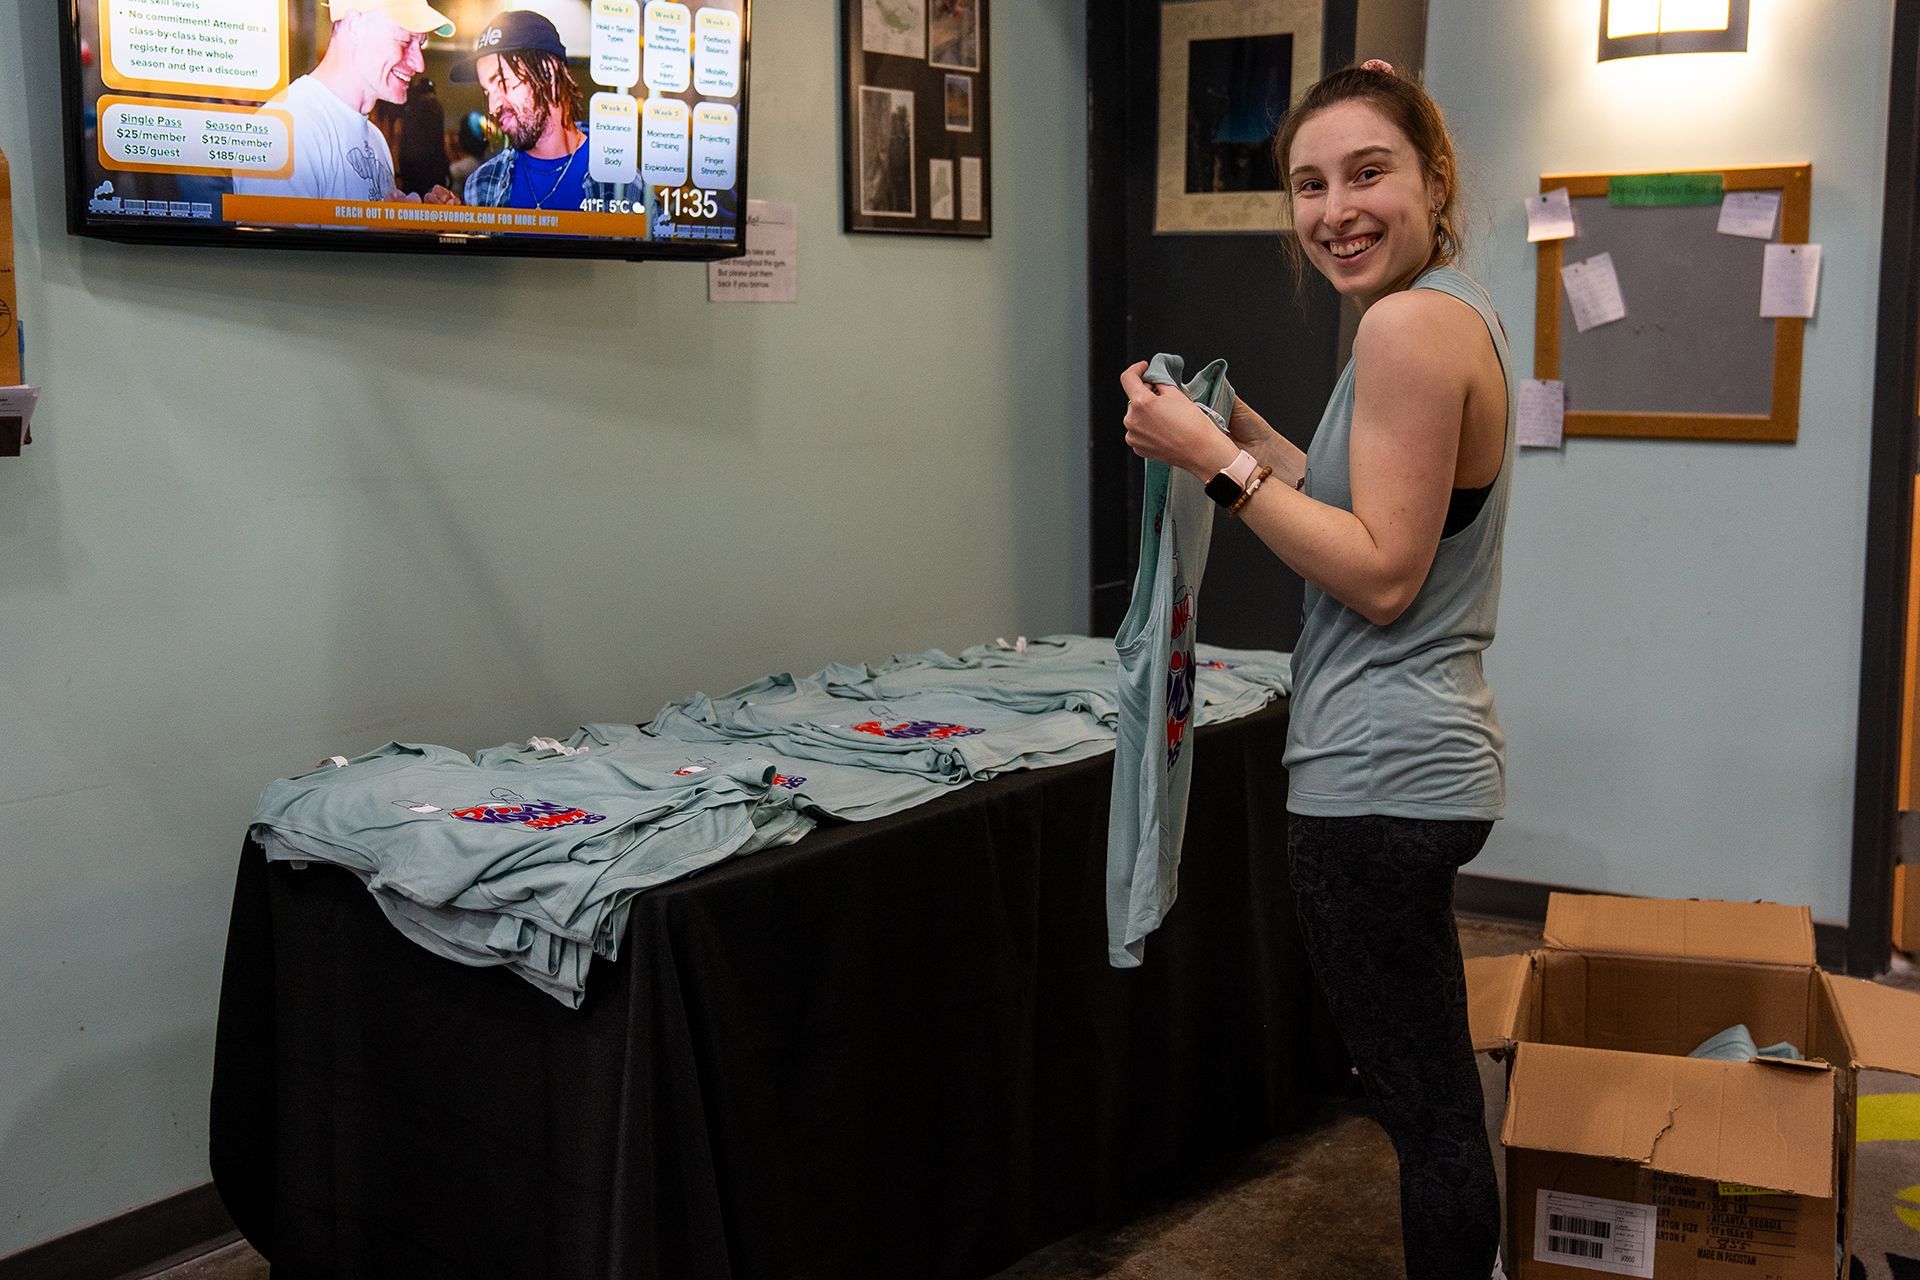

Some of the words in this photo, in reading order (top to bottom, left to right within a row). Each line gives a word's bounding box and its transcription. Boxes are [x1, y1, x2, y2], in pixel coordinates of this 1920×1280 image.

[172, 0, 199, 9] levels
[603, 4, 623, 13] Week
[128, 10, 142, 19] No
[146, 13, 210, 27] commitment!
[213, 19, 244, 31] Attend
[246, 24, 259, 32] on
[655, 11, 674, 20] Week
[705, 18, 723, 26] Week
[615, 25, 635, 33] Terrain
[658, 26, 677, 34] Energy
[129, 26, 196, 41] class-by-class
[199, 34, 226, 45] basis,
[607, 35, 624, 43] Types
[129, 43, 167, 54] register
[171, 46, 184, 54] for
[187, 48, 202, 56] the
[205, 49, 233, 59] whole
[705, 46, 729, 55] Balance
[130, 59, 165, 69] season
[168, 62, 186, 71] and
[189, 65, 204, 74] get
[215, 66, 257, 77] discount!
[613, 65, 630, 73] Down
[705, 67, 728, 77] Mobility
[699, 77, 717, 85] Lower
[719, 79, 734, 89] Body
[601, 104, 621, 112] Week
[653, 108, 672, 116] Week
[120, 113, 154, 125] Single
[157, 116, 182, 128] Pass
[703, 113, 721, 121] Week
[205, 120, 242, 132] Season
[245, 123, 269, 135] Pass
[595, 122, 632, 133] Endurance
[116, 128, 187, 142] $25/member
[646, 130, 684, 140] Momentum
[700, 134, 731, 145] Projecting
[201, 134, 272, 149] $125/member
[650, 141, 679, 151] Climbing
[124, 144, 180, 158] $35/guest
[603, 146, 624, 155] Upper
[209, 150, 266, 163] $185/guest
[704, 157, 724, 166] Finger
[604, 157, 622, 168] Body
[700, 168, 727, 178] Strength
[579, 198, 604, 212] 41°F
[609, 200, 630, 213] 5°C
[659, 187, 718, 219] 11:35
[335, 205, 363, 219] REACH
[366, 207, 382, 219] OUT
[384, 208, 395, 220] TO
[397, 209, 495, 224] CONNER@EVOROCK.COM
[497, 213, 513, 225] FOR
[514, 214, 537, 226] MORE
[538, 215, 559, 227] INFO!
[438, 236, 467, 244] SAMSUNG
[718, 269, 727, 277] But
[1680, 1198, 1706, 1211] WEIGHT
[1656, 1220, 1681, 1231] ARTON
[1683, 1223, 1698, 1233] SIZE
[1656, 1231, 1679, 1242] ARTON
[1697, 1249, 1715, 1261] MADE
[1717, 1250, 1723, 1261] IN
[1725, 1251, 1756, 1266] PAKISTAN
